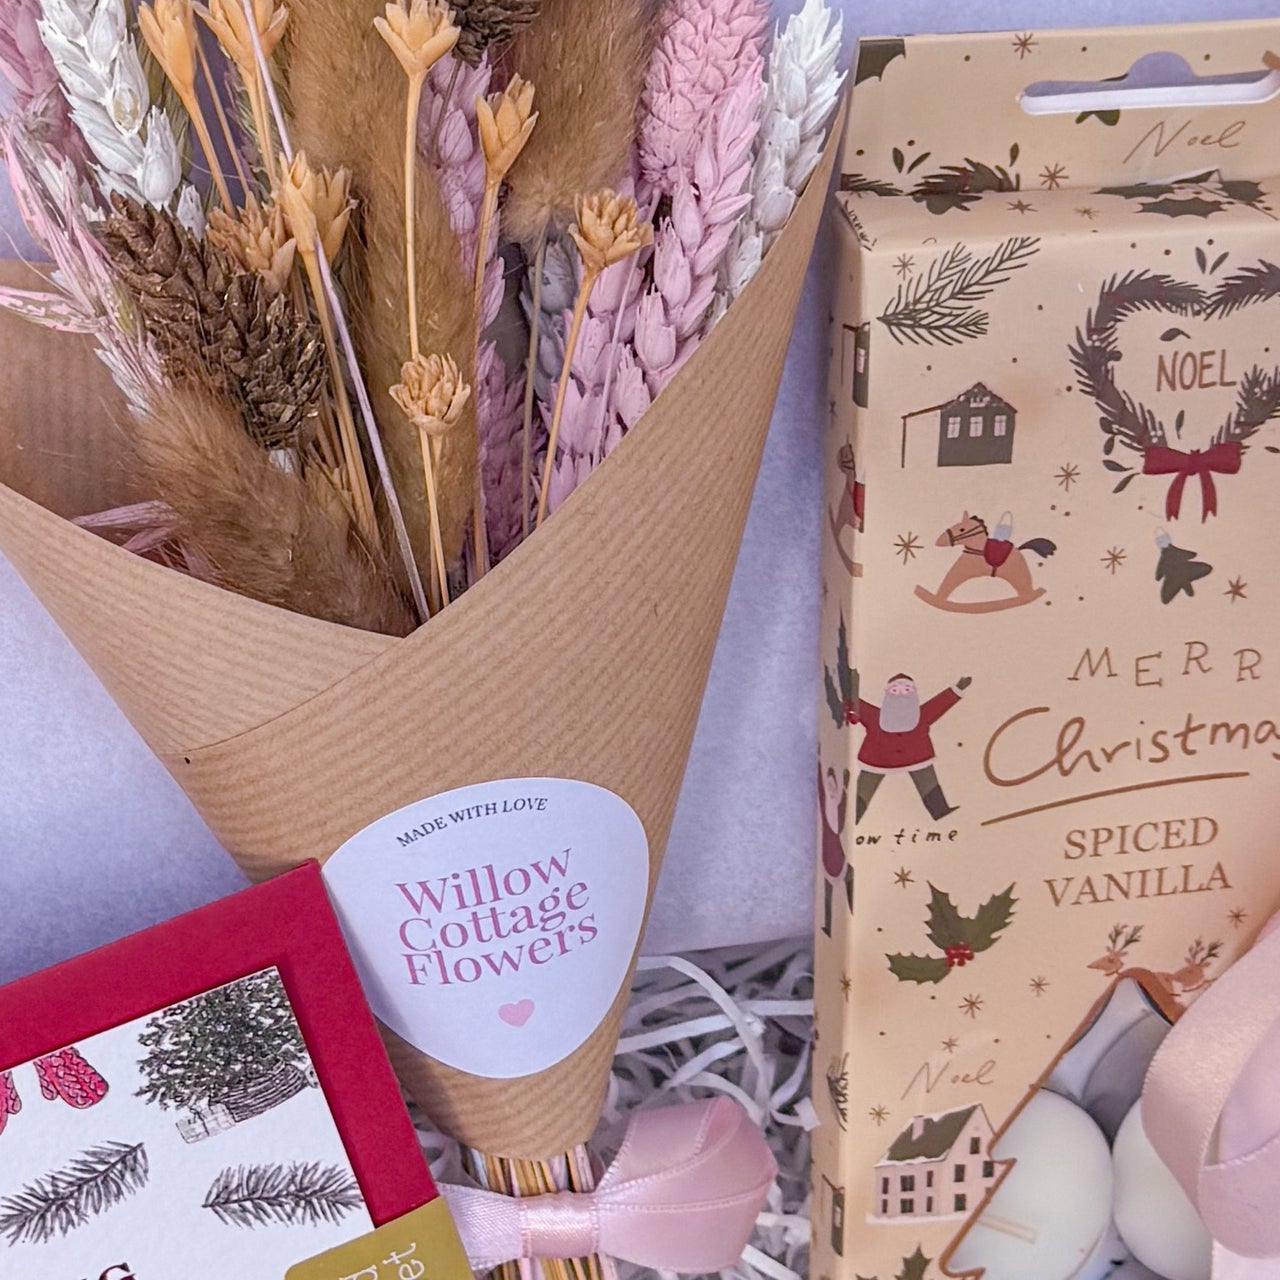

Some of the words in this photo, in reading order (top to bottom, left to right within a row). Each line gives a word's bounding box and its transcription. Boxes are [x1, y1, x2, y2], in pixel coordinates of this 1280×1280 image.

[1121, 119, 1246, 165] Noel
[1155, 349, 1238, 393] NOEL
[395, 816, 448, 848] MADE
[449, 802, 498, 823] WITH
[502, 797, 549, 814] LOVE
[893, 828, 959, 846] time
[1062, 815, 1220, 862] SPICED
[393, 848, 573, 916] Willow
[1043, 860, 1234, 909] VANILLA
[398, 881, 590, 953] Cottage
[401, 913, 599, 986] Flowers
[901, 1059, 997, 1101] Noel
